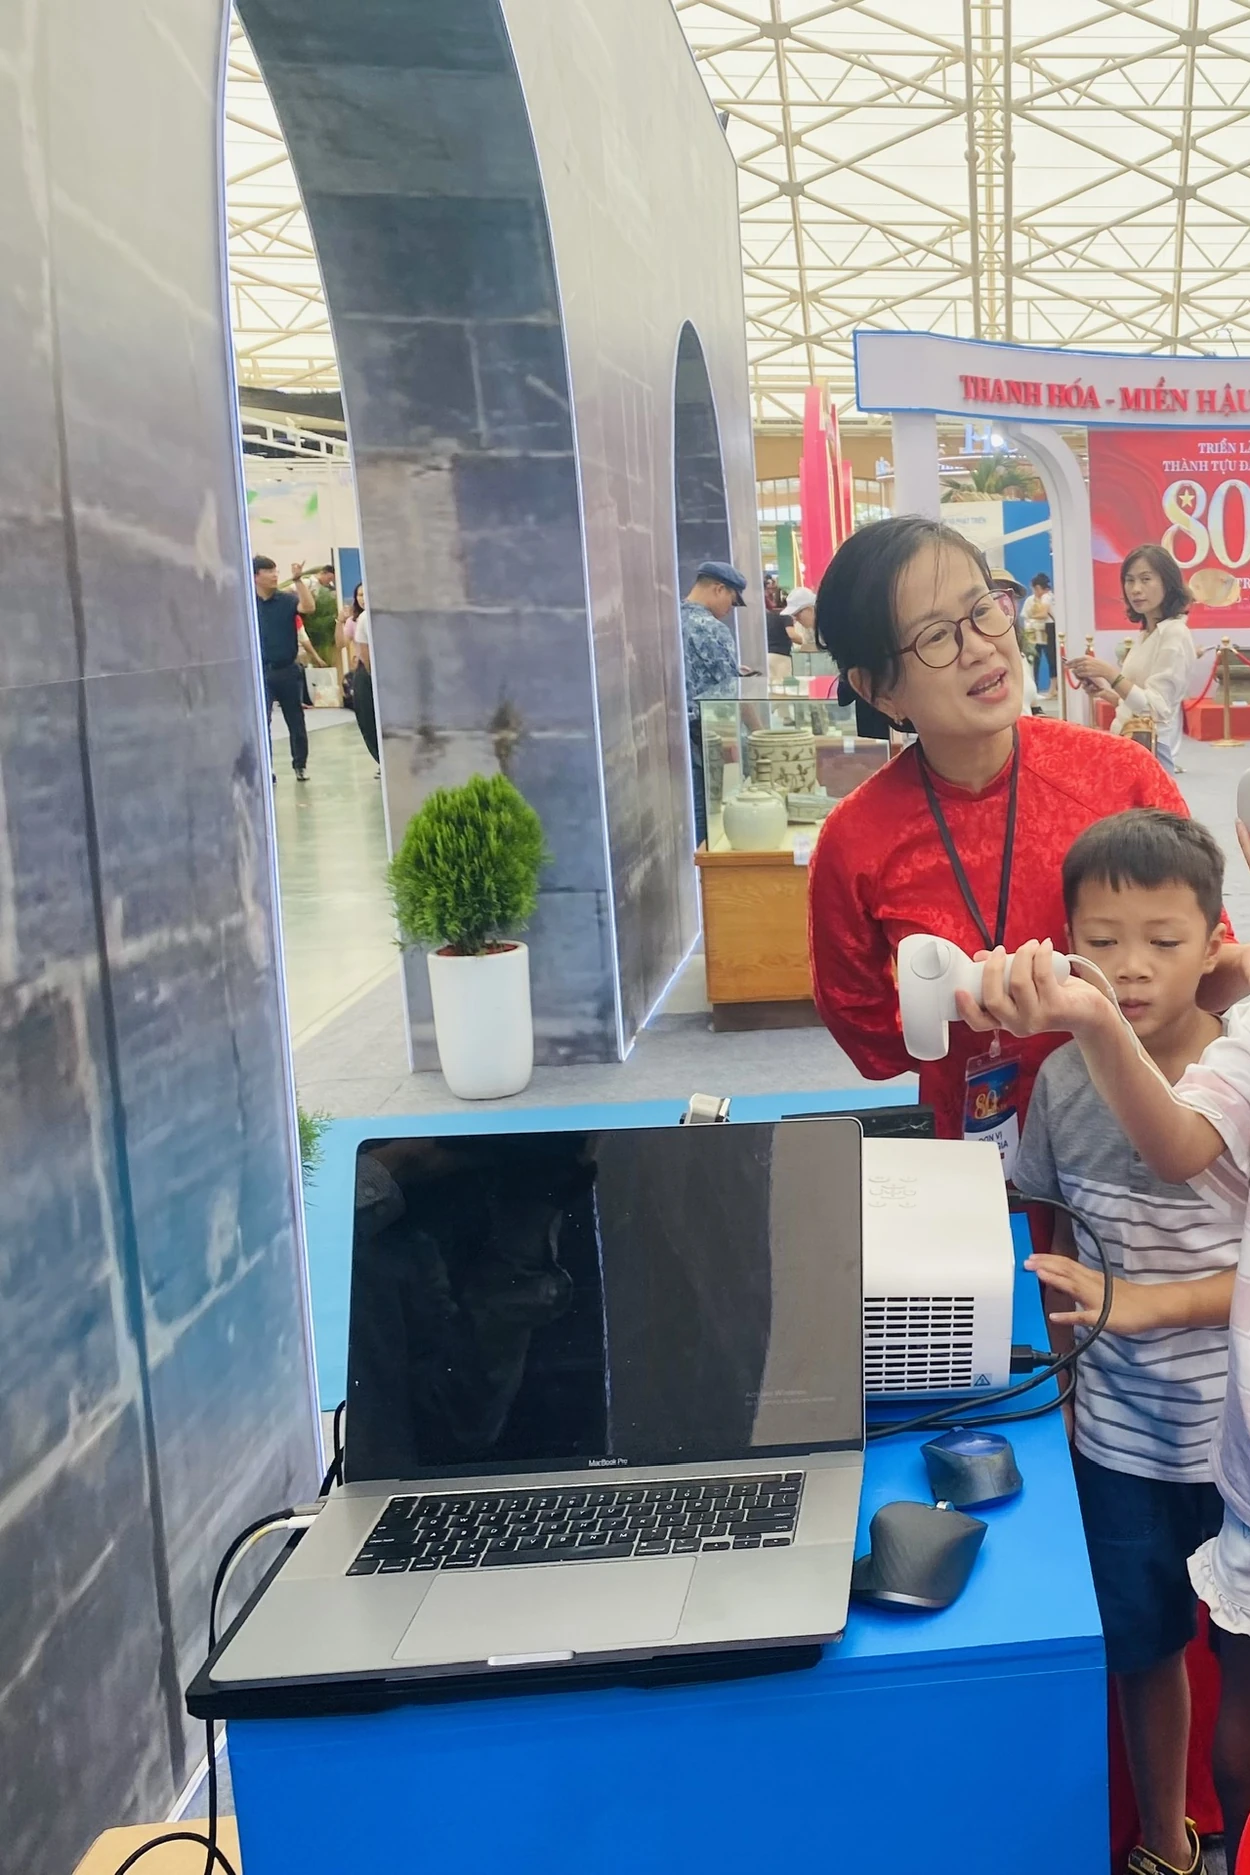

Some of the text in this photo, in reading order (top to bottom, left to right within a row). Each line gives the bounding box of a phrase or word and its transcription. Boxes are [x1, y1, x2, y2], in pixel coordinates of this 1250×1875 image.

[960, 375, 1043, 406] THANH
[1046, 378, 1101, 409] HÓA
[1198, 438, 1236, 454] TRIỂN
[1163, 458, 1209, 472] THÀNH
[1211, 459, 1237, 475] TỰU
[589, 1458, 628, 1467] MacBook Pro
